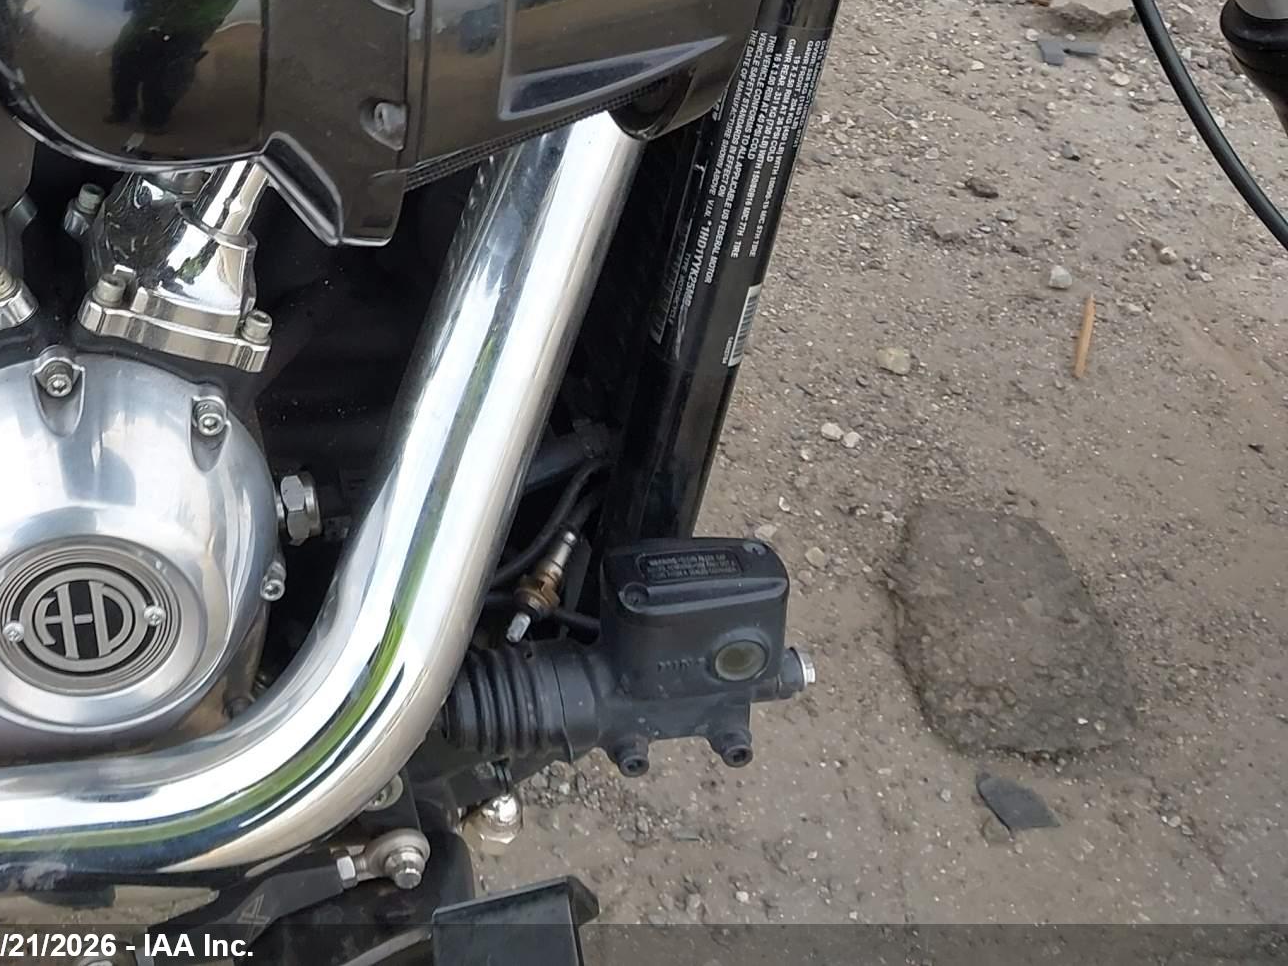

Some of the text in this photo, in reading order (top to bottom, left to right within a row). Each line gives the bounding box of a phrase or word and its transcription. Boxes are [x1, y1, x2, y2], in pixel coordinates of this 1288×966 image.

[748, 30, 758, 45] THE
[743, 46, 753, 67] DATE
[784, 39, 796, 62] GAWR
[803, 40, 813, 64] GAWR
[740, 68, 747, 80] OF
[777, 64, 789, 85] REAR
[795, 66, 806, 91] FRONT
[782, 89, 791, 103] RIM
[718, 32, 767, 197] VEHICLE SAFETY STANDARDS IN EFFECT ON
[724, 80, 744, 138] MANUFACTURE
[760, 101, 769, 113] AT
[769, 106, 777, 117] KG
[779, 104, 787, 115] AT
[785, 112, 793, 124] KG
[754, 124, 763, 137] PSI
[773, 126, 781, 139] PSI
[716, 139, 728, 168] SHOWN
[747, 137, 759, 159] COLD
[766, 140, 777, 162] COLD
[704, 35, 776, 283] THIS VEHICLE CONFORMS TO ALL APPLICABLE US FEDERAL MOTOR
[755, 150, 766, 168] WITH
[772, 156, 781, 174] WITH
[709, 168, 721, 195] ABOVE
[737, 222, 746, 236] 77H
[731, 241, 741, 257] TIRE
[749, 240, 759, 256] TIRE
